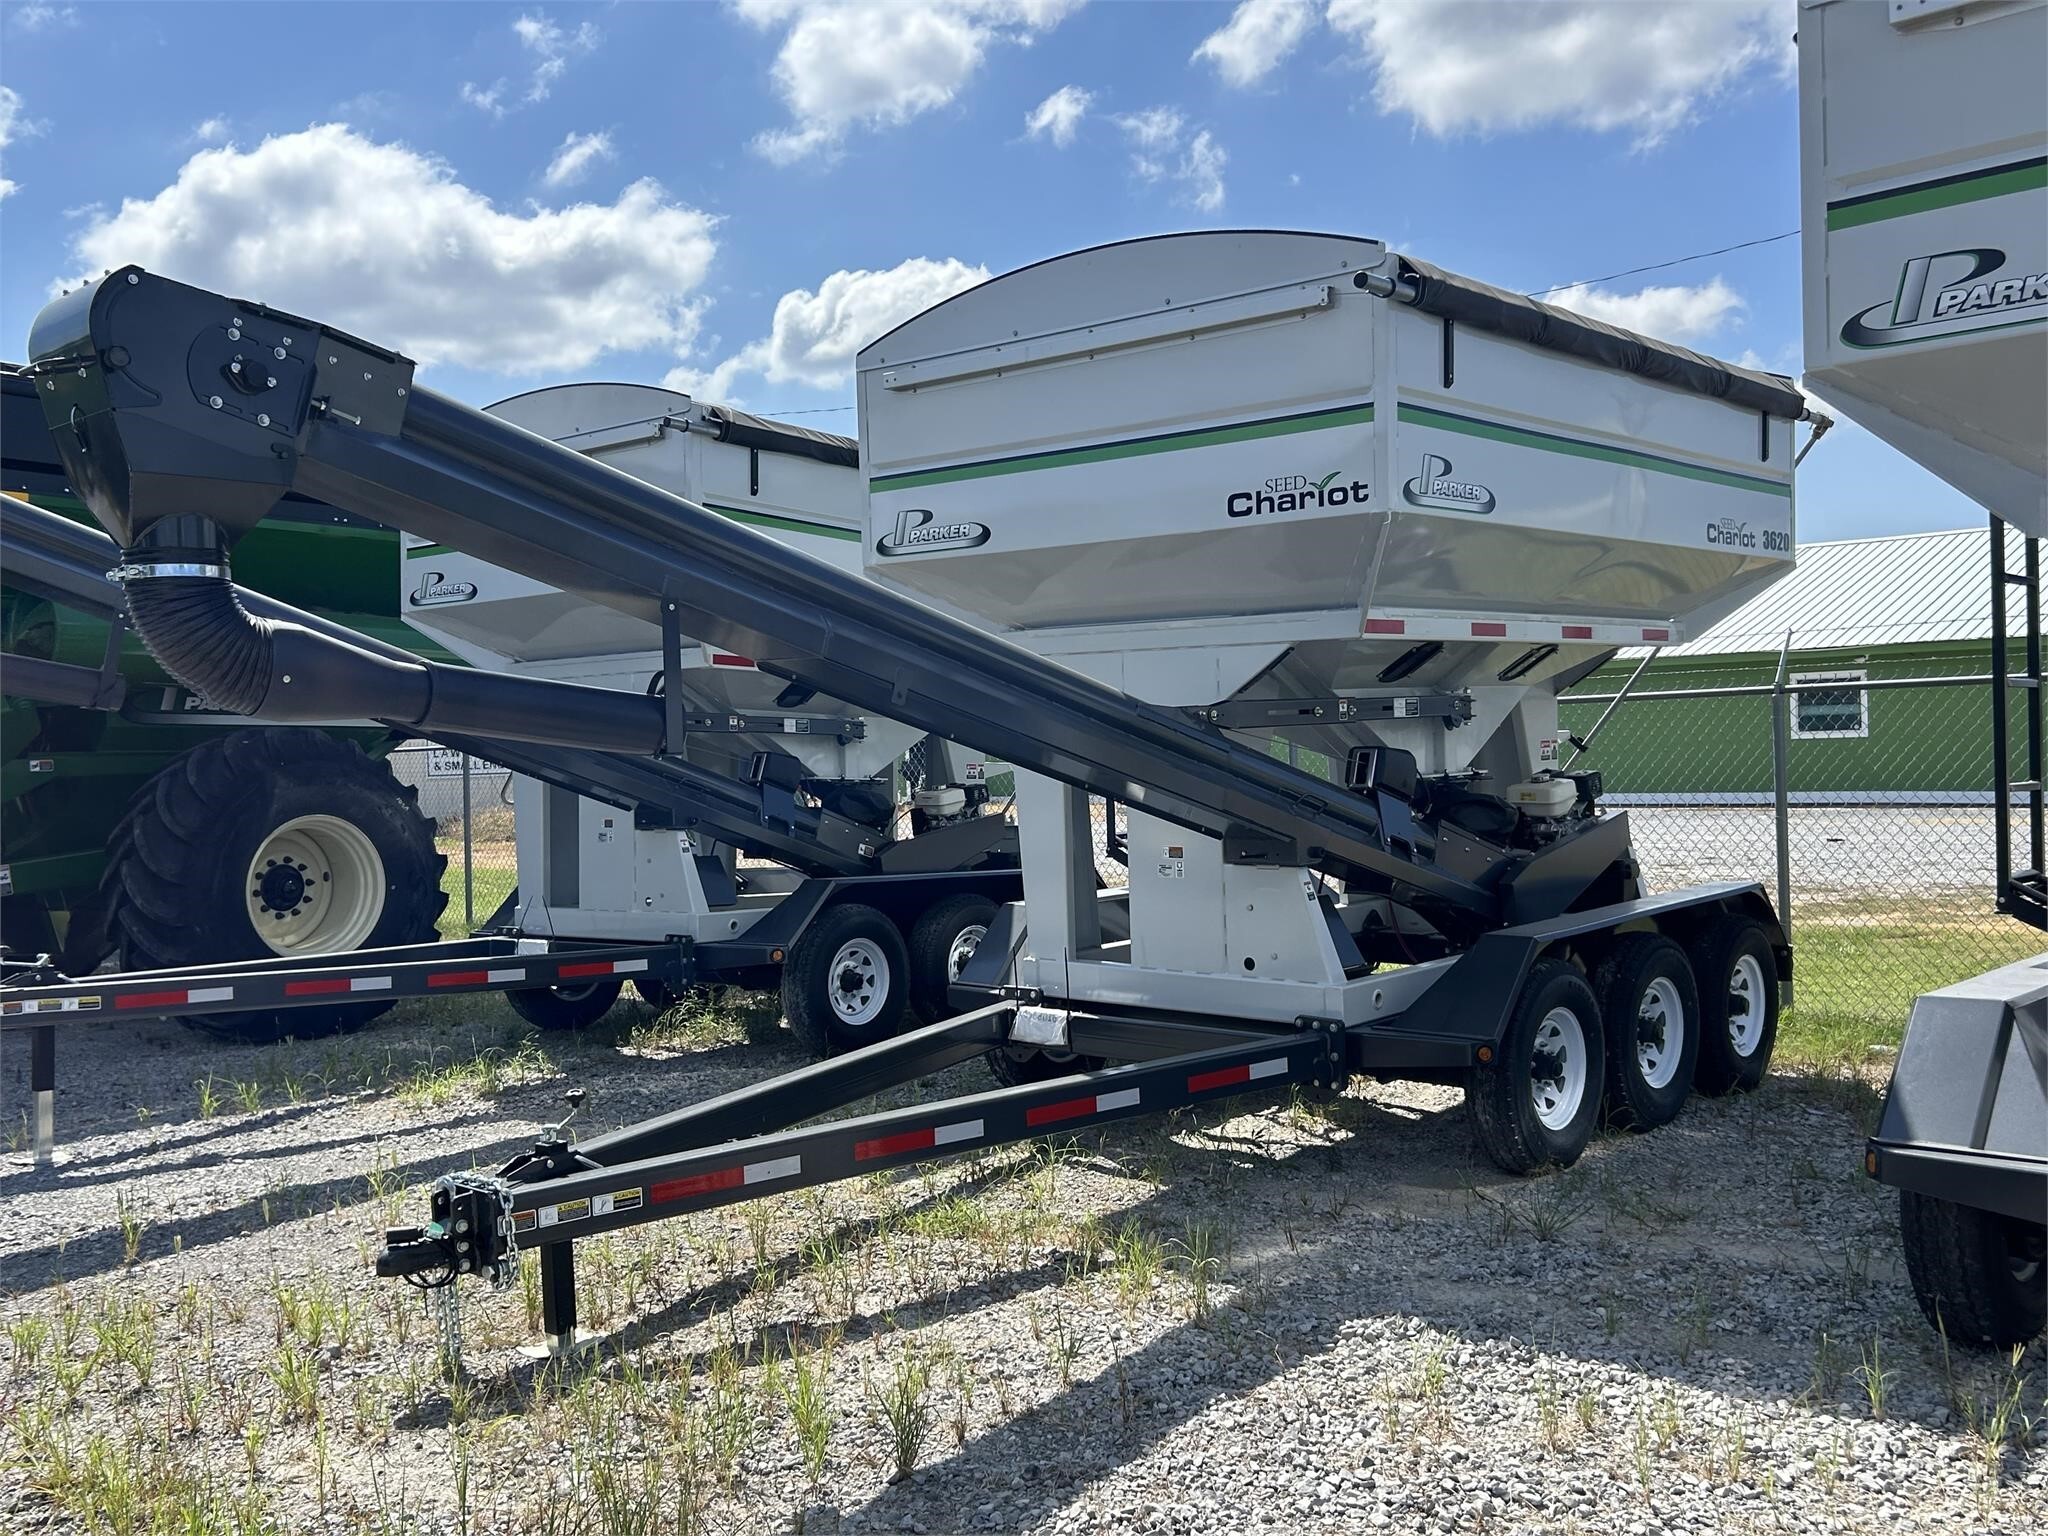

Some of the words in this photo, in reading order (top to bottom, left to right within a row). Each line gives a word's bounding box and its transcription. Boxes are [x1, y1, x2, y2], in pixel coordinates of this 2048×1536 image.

[1264, 474, 1308, 495] SEED
[1431, 479, 1481, 500] PARKER
[1227, 479, 1370, 518] Chariot
[908, 523, 970, 543] PARKER
[1707, 522, 1756, 548] Chariot
[1762, 529, 1790, 552] 3620
[428, 583, 467, 597] PARKER
[434, 761, 441, 771] &
